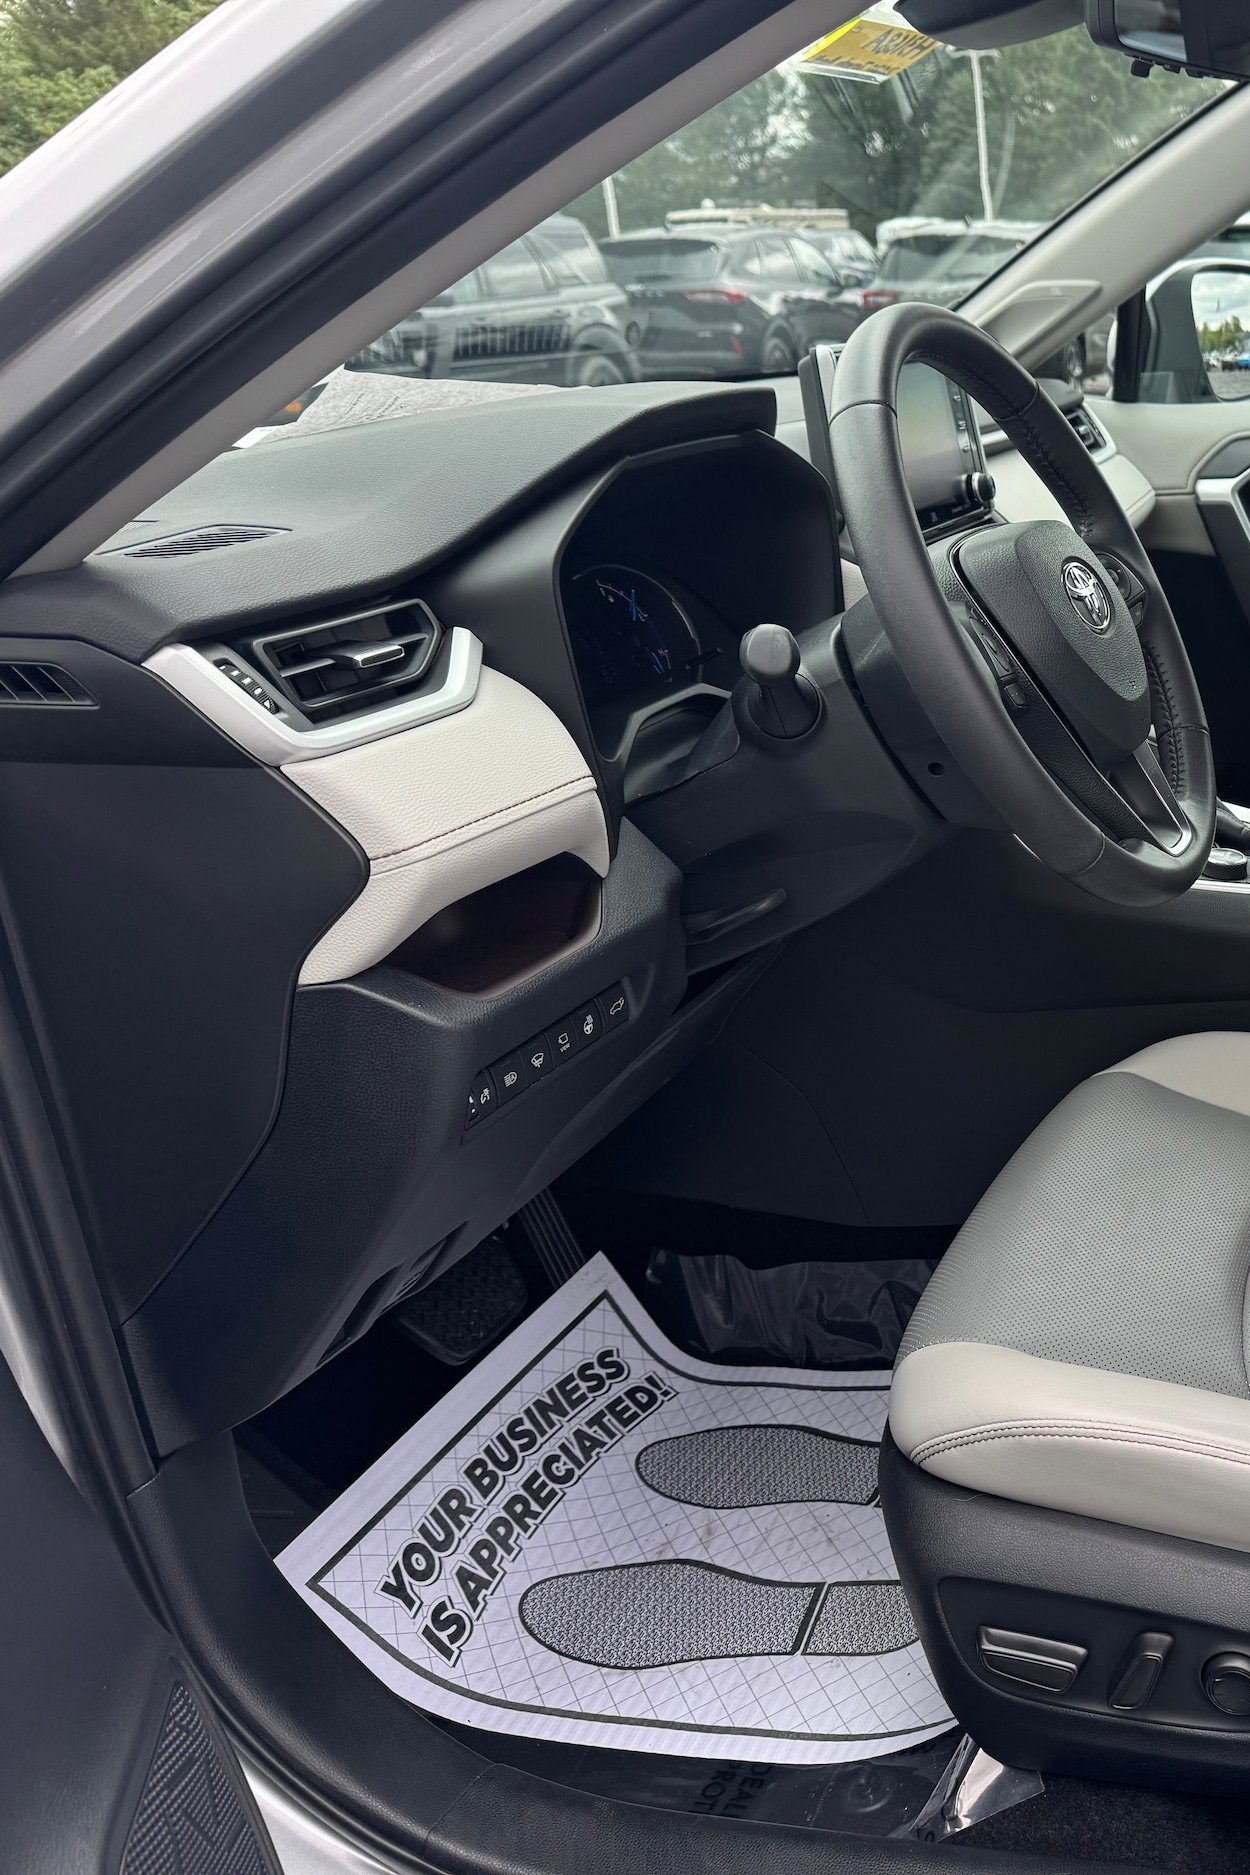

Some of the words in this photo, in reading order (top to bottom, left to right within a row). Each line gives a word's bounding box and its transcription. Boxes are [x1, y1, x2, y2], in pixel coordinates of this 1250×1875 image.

[377, 1484, 484, 1617] YOUR
[461, 1348, 629, 1502] BUSINESS
[419, 1597, 474, 1665] IS
[453, 1374, 678, 1619] APPRECIATED!
